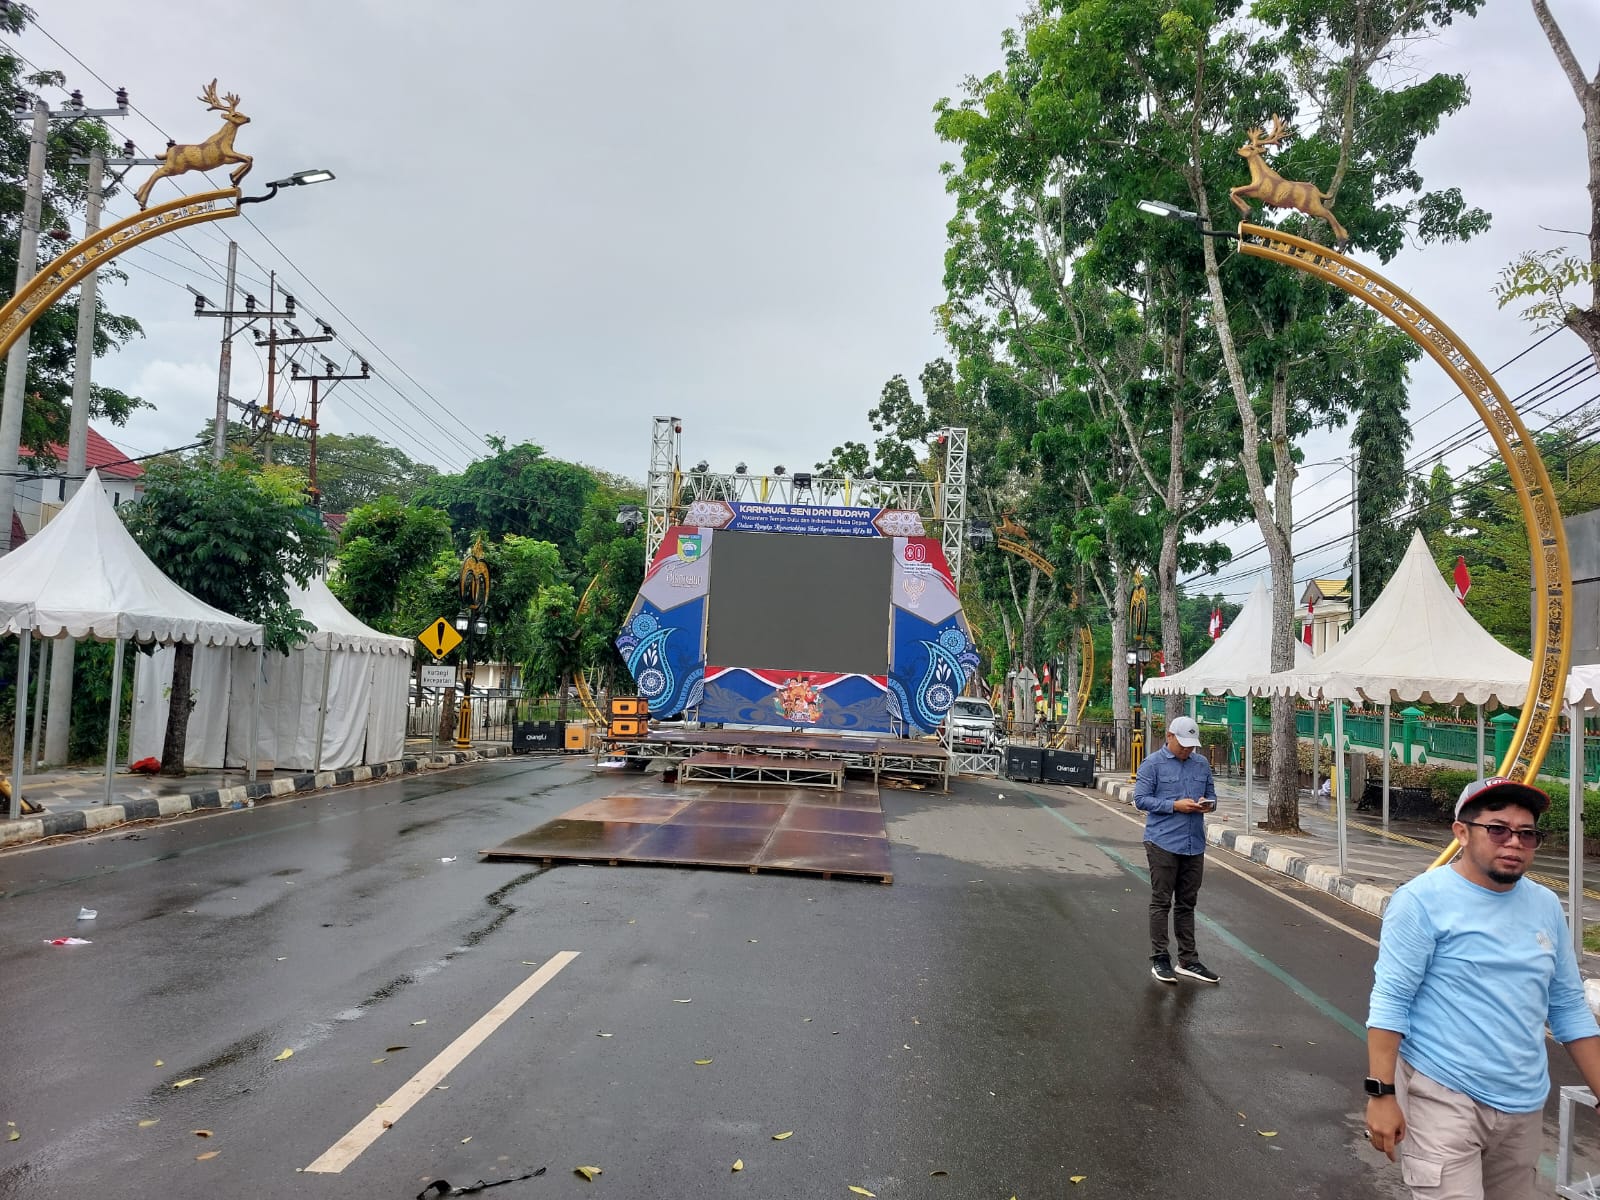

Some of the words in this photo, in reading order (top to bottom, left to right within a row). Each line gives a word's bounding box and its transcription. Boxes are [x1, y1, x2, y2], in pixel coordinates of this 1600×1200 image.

[739, 505, 789, 515] KARNAVAL
[790, 507, 811, 516] SENI
[812, 509, 832, 517] DAN
[832, 509, 871, 519] BUDAYA
[904, 544, 926, 562] 80
